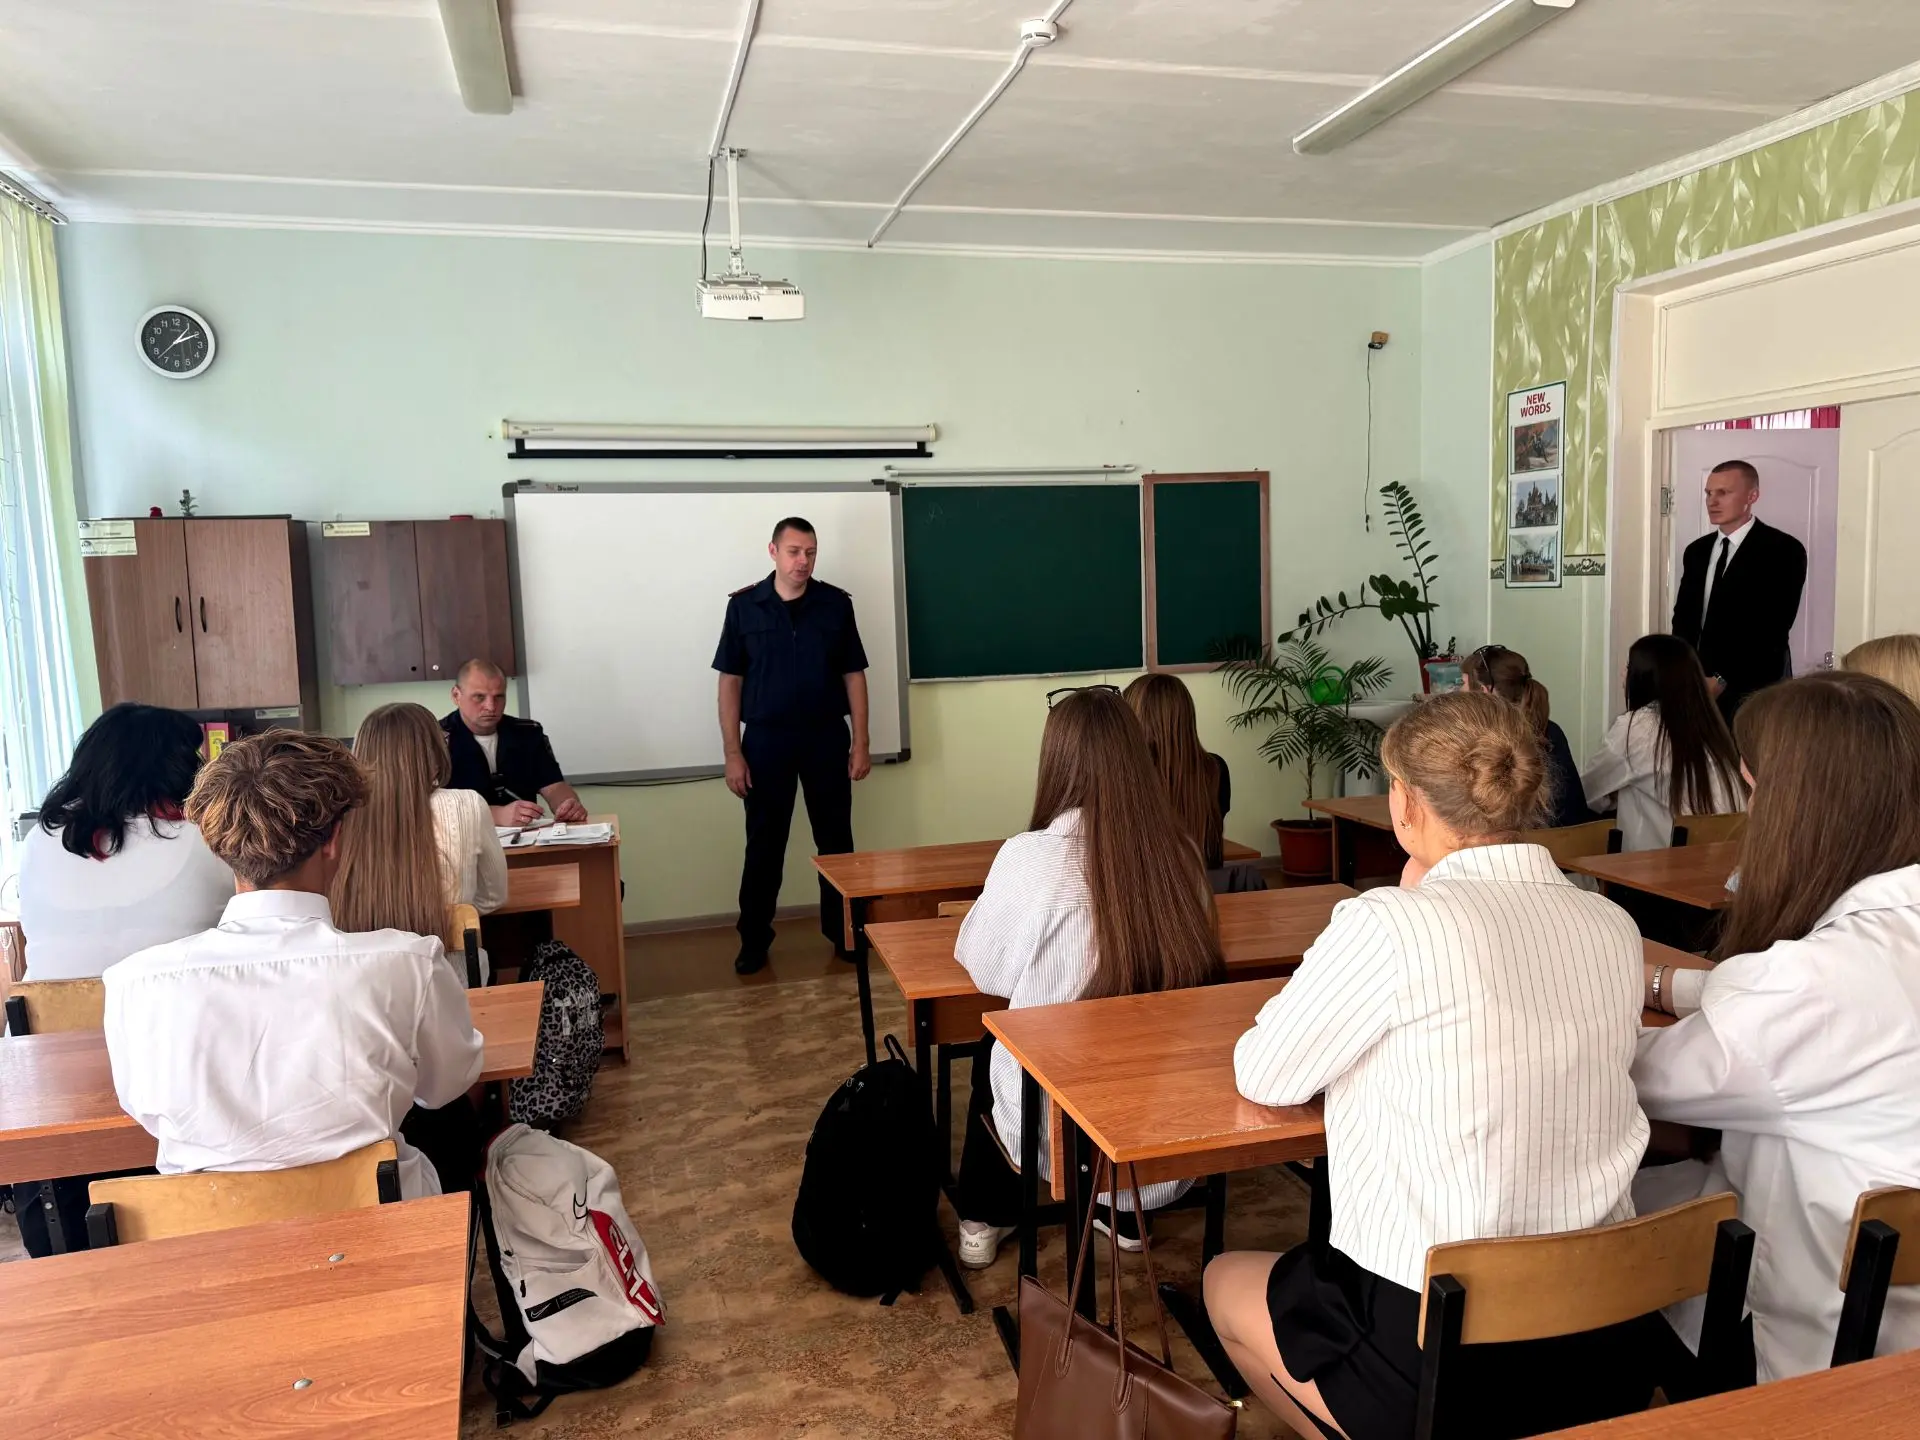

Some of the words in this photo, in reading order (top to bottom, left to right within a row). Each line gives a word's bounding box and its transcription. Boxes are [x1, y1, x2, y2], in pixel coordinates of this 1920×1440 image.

[161, 320, 168, 328] 11
[172, 318, 181, 326] 12
[153, 327, 162, 335] 10
[1526, 391, 1546, 406] NEW
[1520, 402, 1551, 418] WORDS
[965, 1240, 979, 1248] FILA
